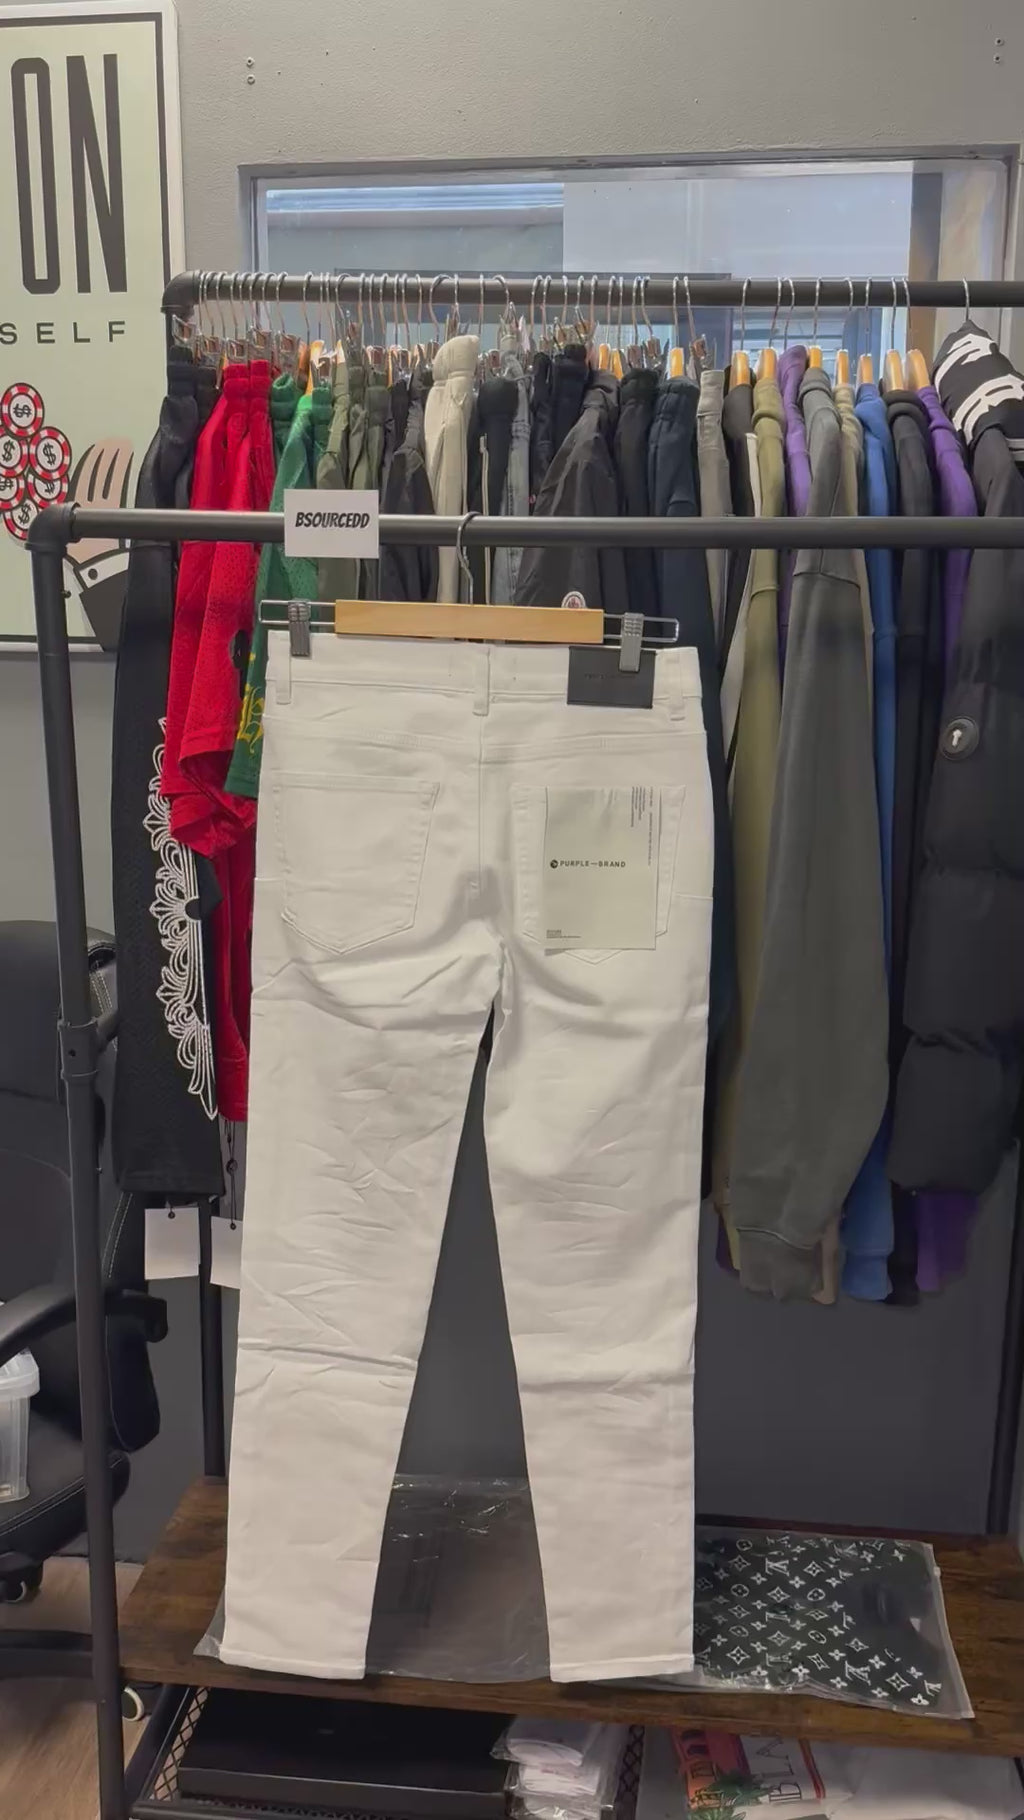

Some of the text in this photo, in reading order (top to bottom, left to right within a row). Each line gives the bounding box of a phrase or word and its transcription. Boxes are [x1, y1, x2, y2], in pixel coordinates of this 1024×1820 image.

[11, 53, 128, 295] ON
[0, 321, 125, 345] SELF
[295, 511, 370, 529] BSOURCEDD
